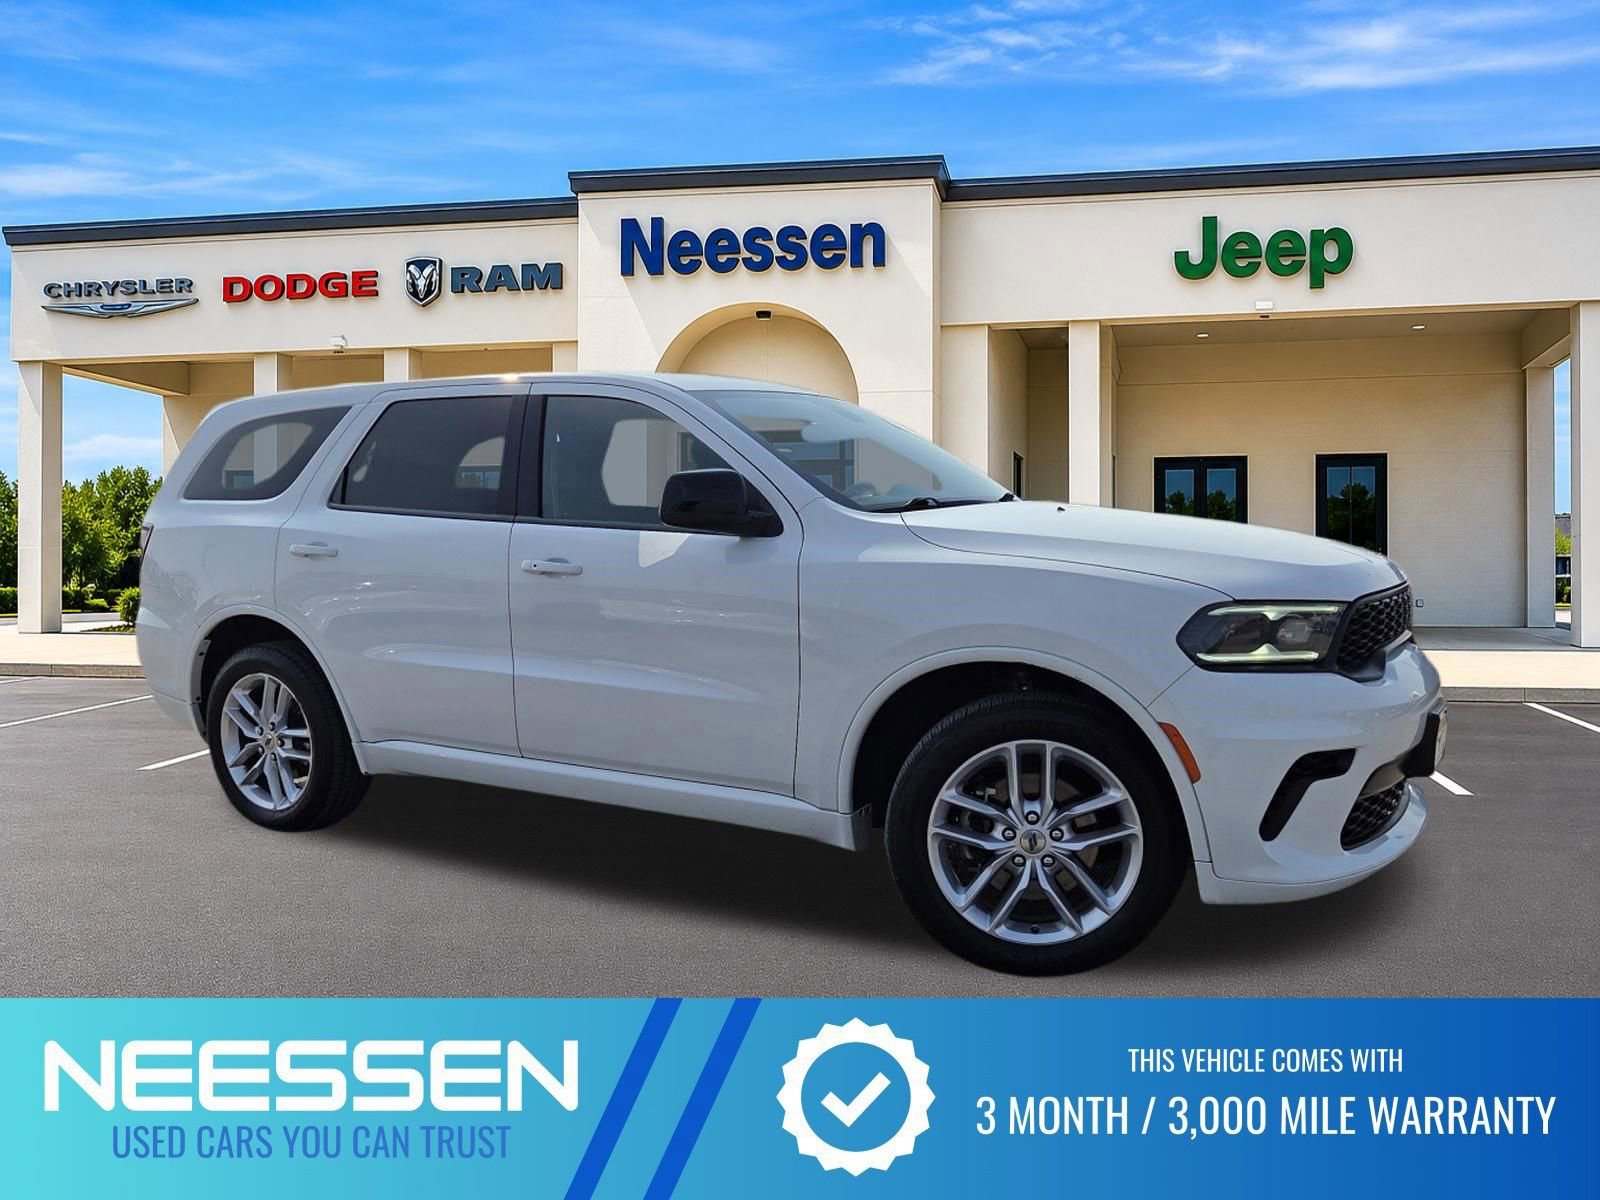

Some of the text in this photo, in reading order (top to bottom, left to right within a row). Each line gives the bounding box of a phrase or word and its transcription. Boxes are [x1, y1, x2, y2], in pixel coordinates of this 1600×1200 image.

[620, 216, 887, 277] Neessen
[1174, 216, 1354, 289] Jeep
[43, 277, 194, 299] CHRYSLER
[222, 270, 379, 303] DODGE
[450, 262, 563, 294] RAM
